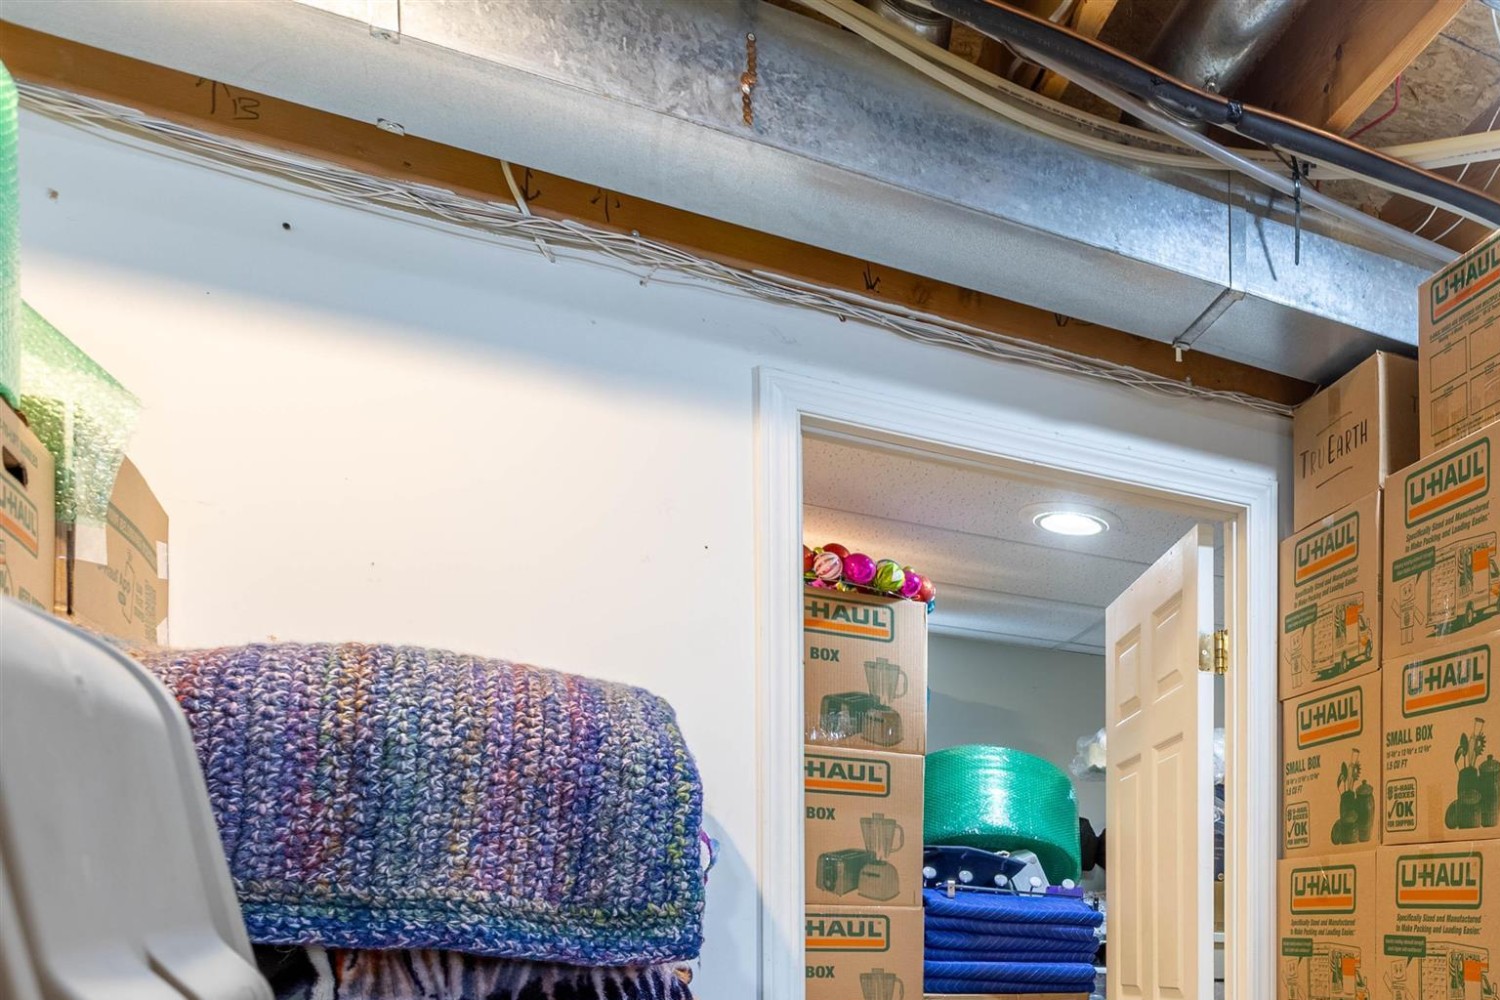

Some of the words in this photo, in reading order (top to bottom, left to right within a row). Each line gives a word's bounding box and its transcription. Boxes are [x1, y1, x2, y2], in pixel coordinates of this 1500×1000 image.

[1435, 247, 1500, 304] U-HAUL
[1410, 451, 1484, 505] U-HAUL
[1299, 523, 1354, 567] U-HAUL
[810, 647, 839, 662] BOX
[1408, 656, 1484, 696] U-HAUL
[1301, 697, 1358, 730] U-HAUL
[1386, 727, 1412, 747] SMALL
[1416, 724, 1433, 741] BOX
[1286, 758, 1306, 776] SMALL
[1308, 755, 1321, 770] BOX
[806, 806, 835, 820] BOX
[1396, 802, 1414, 818] OK
[1295, 873, 1352, 896] U-HAUL
[1401, 862, 1476, 887] U-HAUL
[805, 966, 835, 978] BOX
